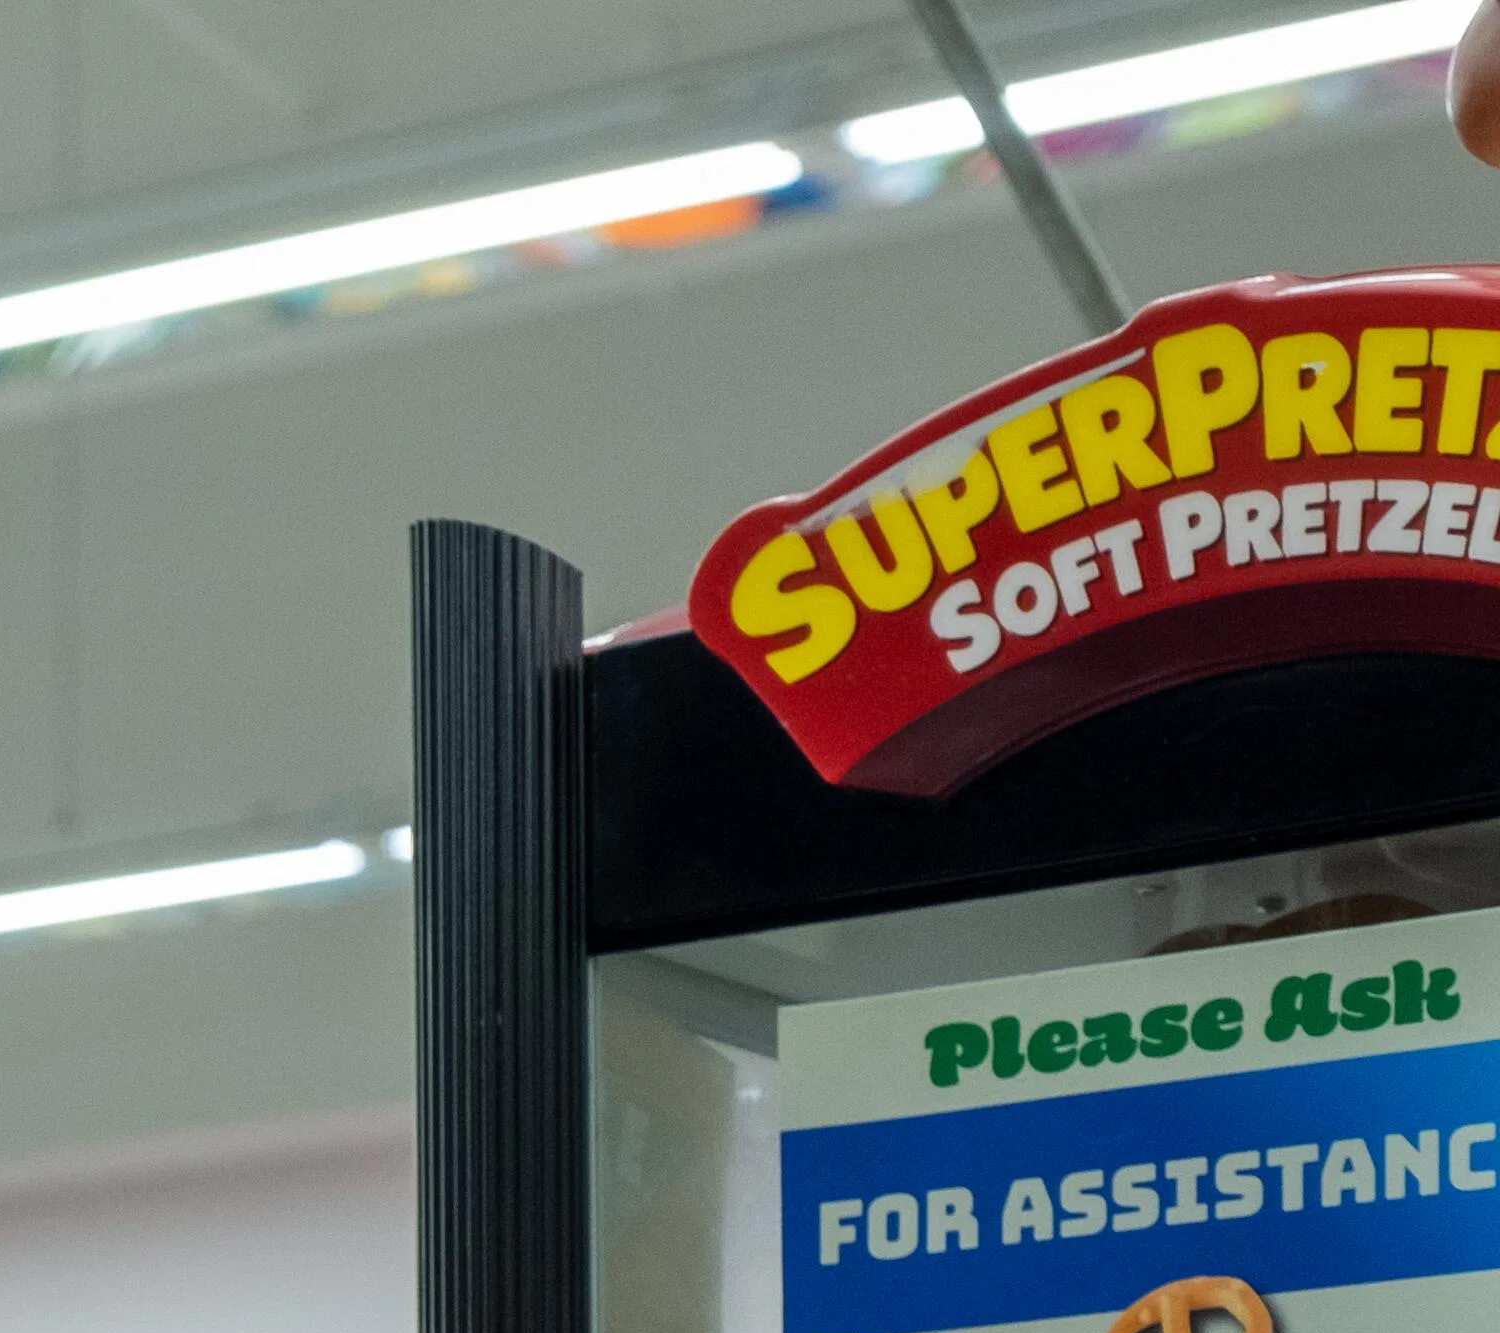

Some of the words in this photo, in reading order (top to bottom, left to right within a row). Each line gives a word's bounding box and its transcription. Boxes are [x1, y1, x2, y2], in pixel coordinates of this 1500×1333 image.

[730, 322, 1500, 685] SUPERPRET
[930, 520, 1145, 674] SOFT
[925, 996, 1245, 1088] Please
[1264, 959, 1462, 1043] Ask
[819, 1187, 978, 1267] FOR
[1001, 1122, 1498, 1246] ASSISTANC
